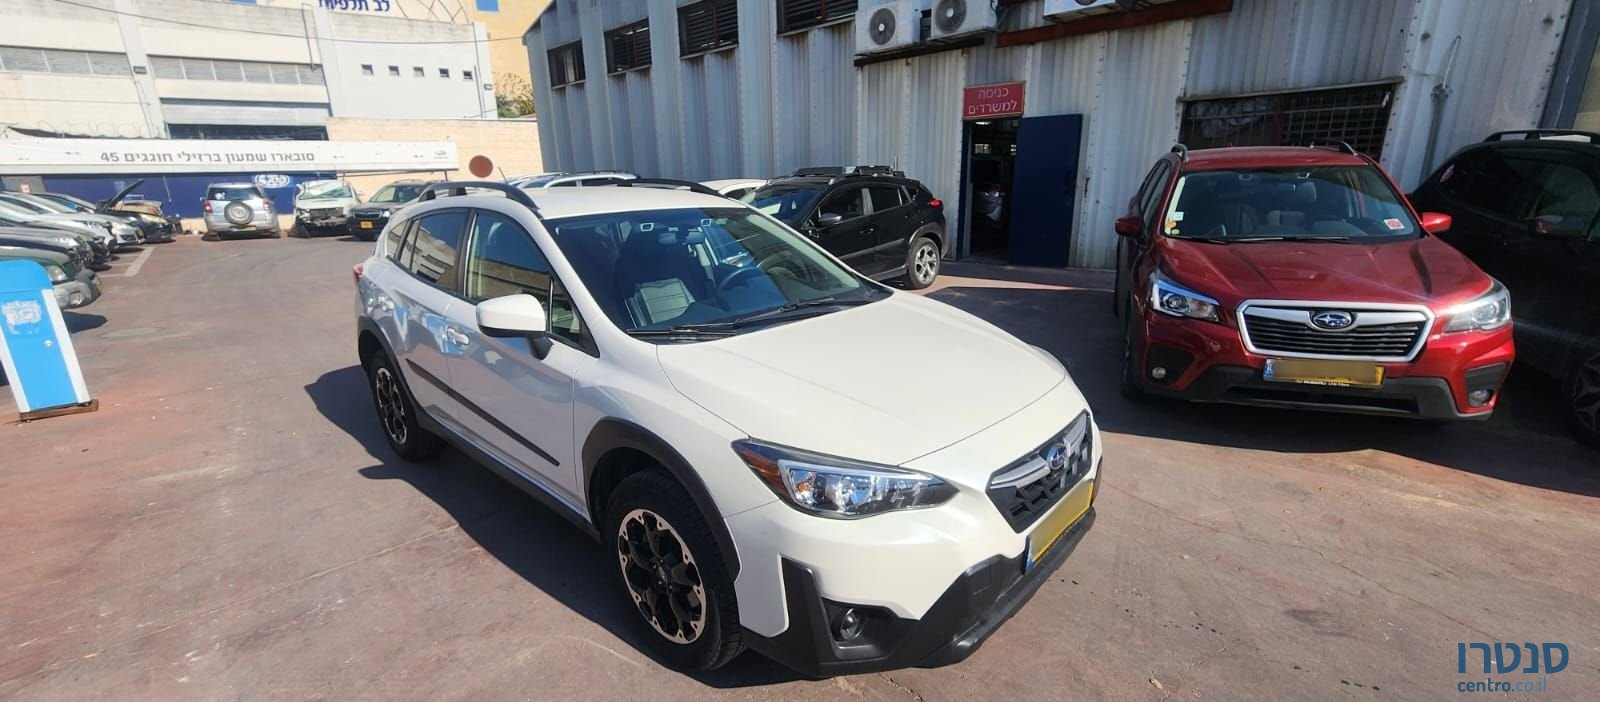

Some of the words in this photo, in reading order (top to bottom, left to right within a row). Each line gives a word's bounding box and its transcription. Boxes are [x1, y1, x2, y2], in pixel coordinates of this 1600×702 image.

[373, 0, 390, 11] לב
[978, 87, 1009, 99] כניסה
[968, 99, 1018, 115] למשרדים
[100, 151, 120, 162] 45
[123, 152, 174, 162] חוגגים
[176, 151, 221, 162] ברזילי
[225, 152, 267, 164] שמעון
[270, 152, 315, 161] סובארו
